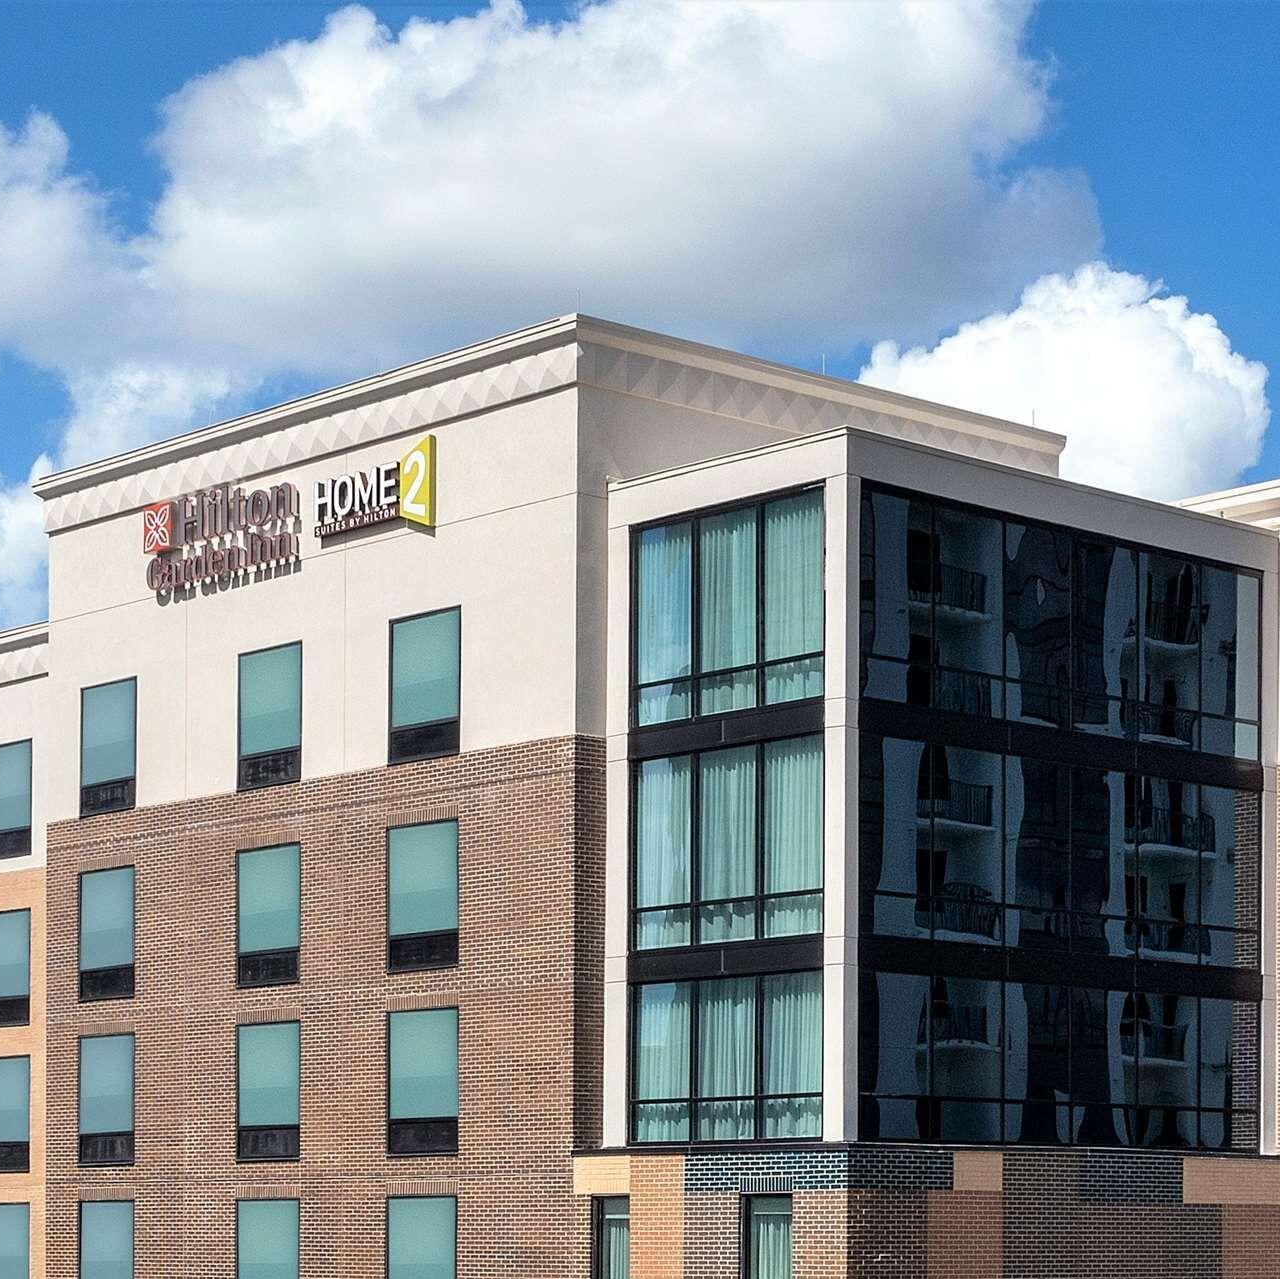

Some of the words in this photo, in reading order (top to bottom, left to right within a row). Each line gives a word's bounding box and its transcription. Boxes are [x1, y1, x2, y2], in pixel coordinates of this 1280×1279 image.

[174, 482, 300, 547] Hilton
[313, 461, 398, 522] HOME
[403, 450, 427, 517] 2
[315, 520, 346, 537] SUITES
[349, 517, 361, 528] BY
[363, 508, 397, 523] HILTON
[146, 545, 246, 591] Garden
[246, 531, 300, 567] Inn
